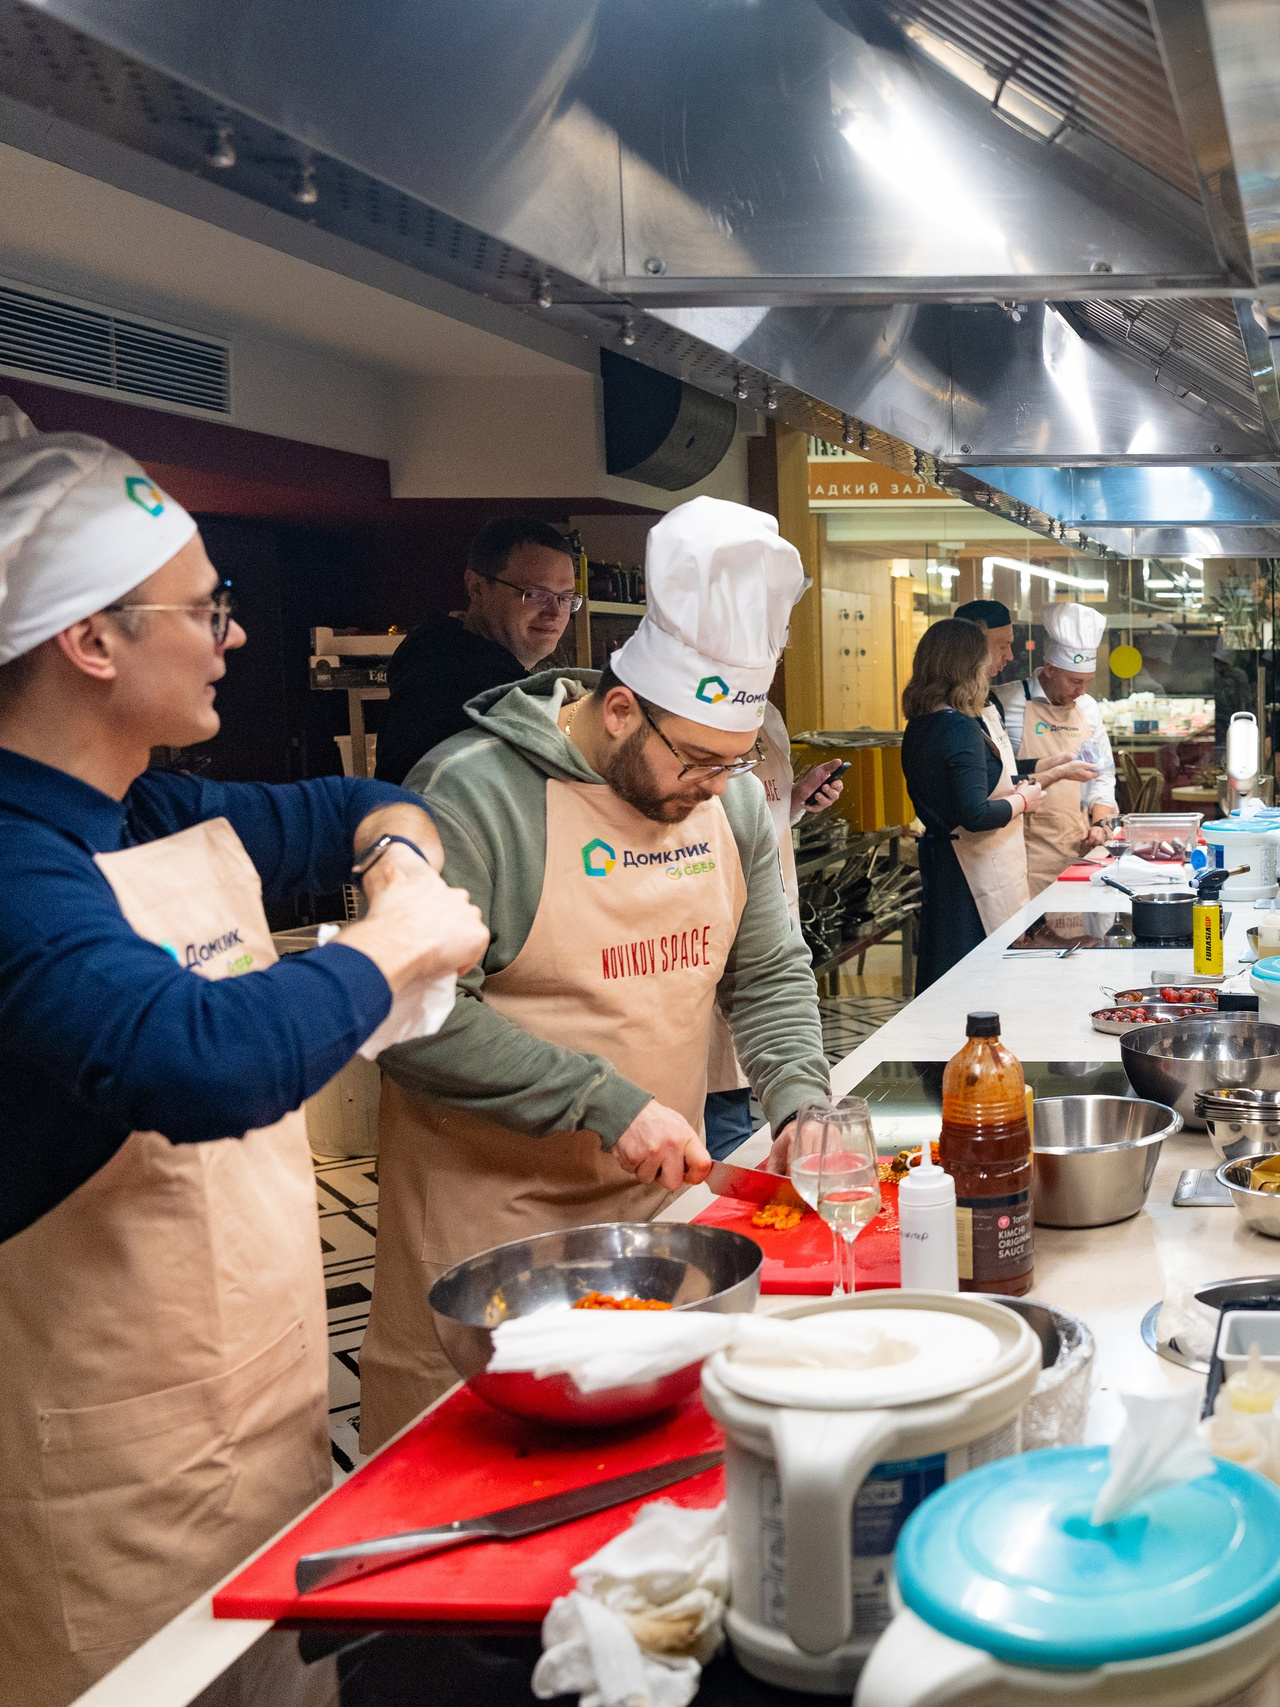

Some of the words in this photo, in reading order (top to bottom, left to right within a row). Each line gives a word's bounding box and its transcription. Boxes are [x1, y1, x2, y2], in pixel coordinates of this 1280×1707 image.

[808, 482, 879, 496] АДКИЙ
[891, 484, 926, 495] ЗАЛ
[623, 842, 711, 868] Домклик
[684, 861, 716, 876] СБЕР
[602, 939, 655, 980] NOVIKOV
[660, 925, 711, 973] SPACE
[998, 1225, 1026, 1240] KIMCHI
[998, 1245, 1025, 1259] SAUCE
